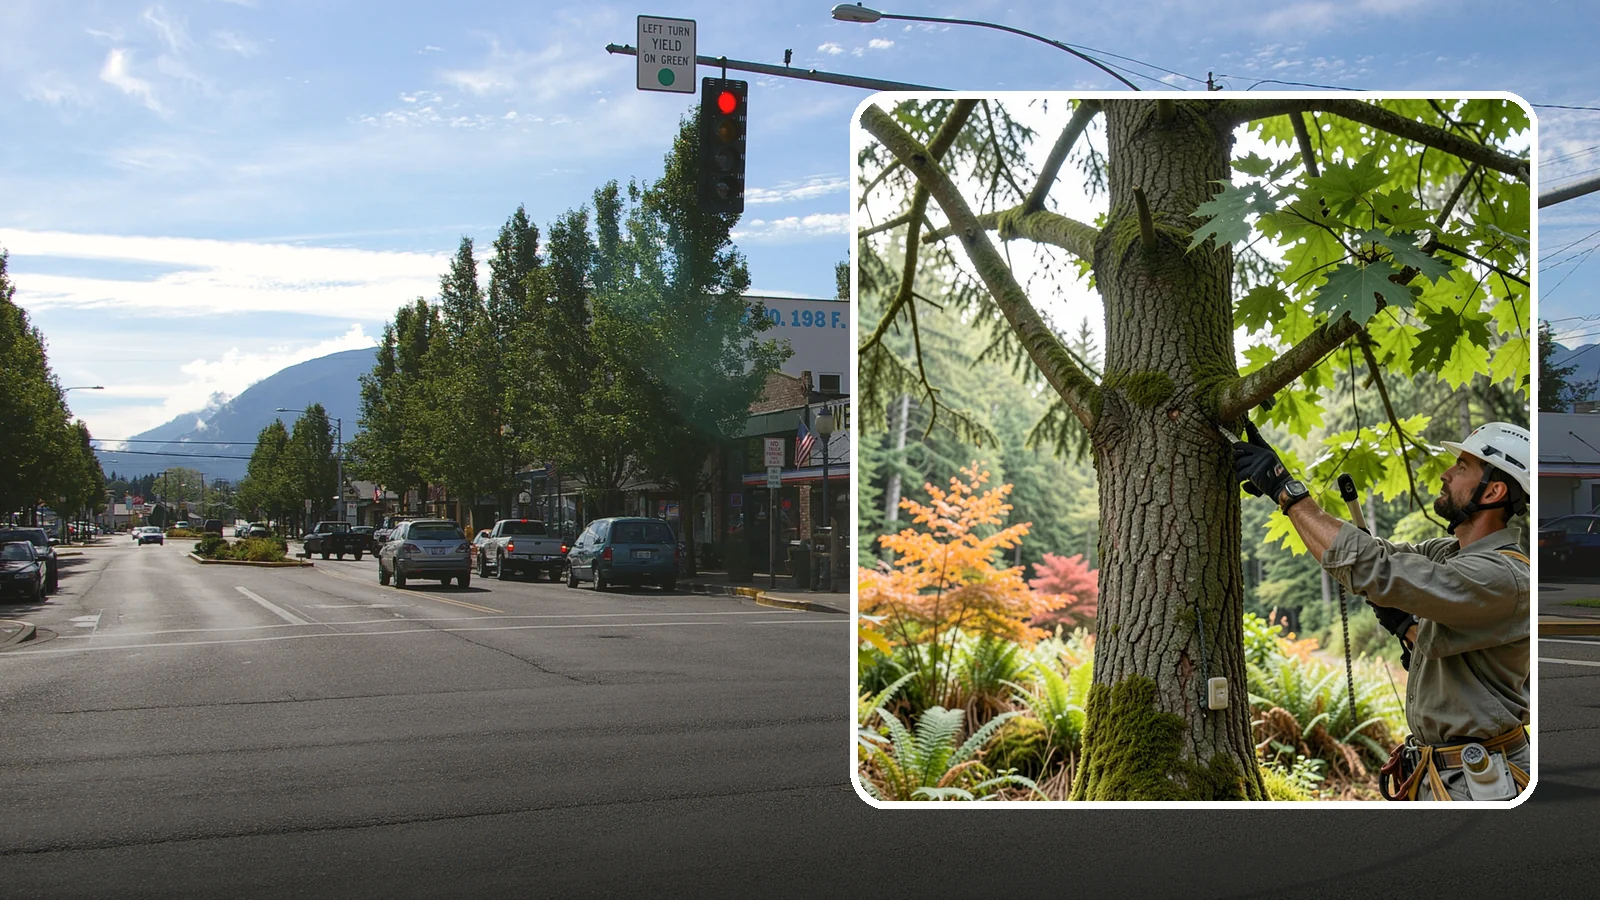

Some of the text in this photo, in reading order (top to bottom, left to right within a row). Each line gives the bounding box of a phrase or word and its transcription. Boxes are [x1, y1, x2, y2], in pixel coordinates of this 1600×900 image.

[643, 23, 690, 36] LEFT TURN
[652, 38, 682, 51] YIELD
[644, 53, 688, 66] ON GREEN
[791, 309, 826, 328] 198
[831, 311, 846, 329] F.
